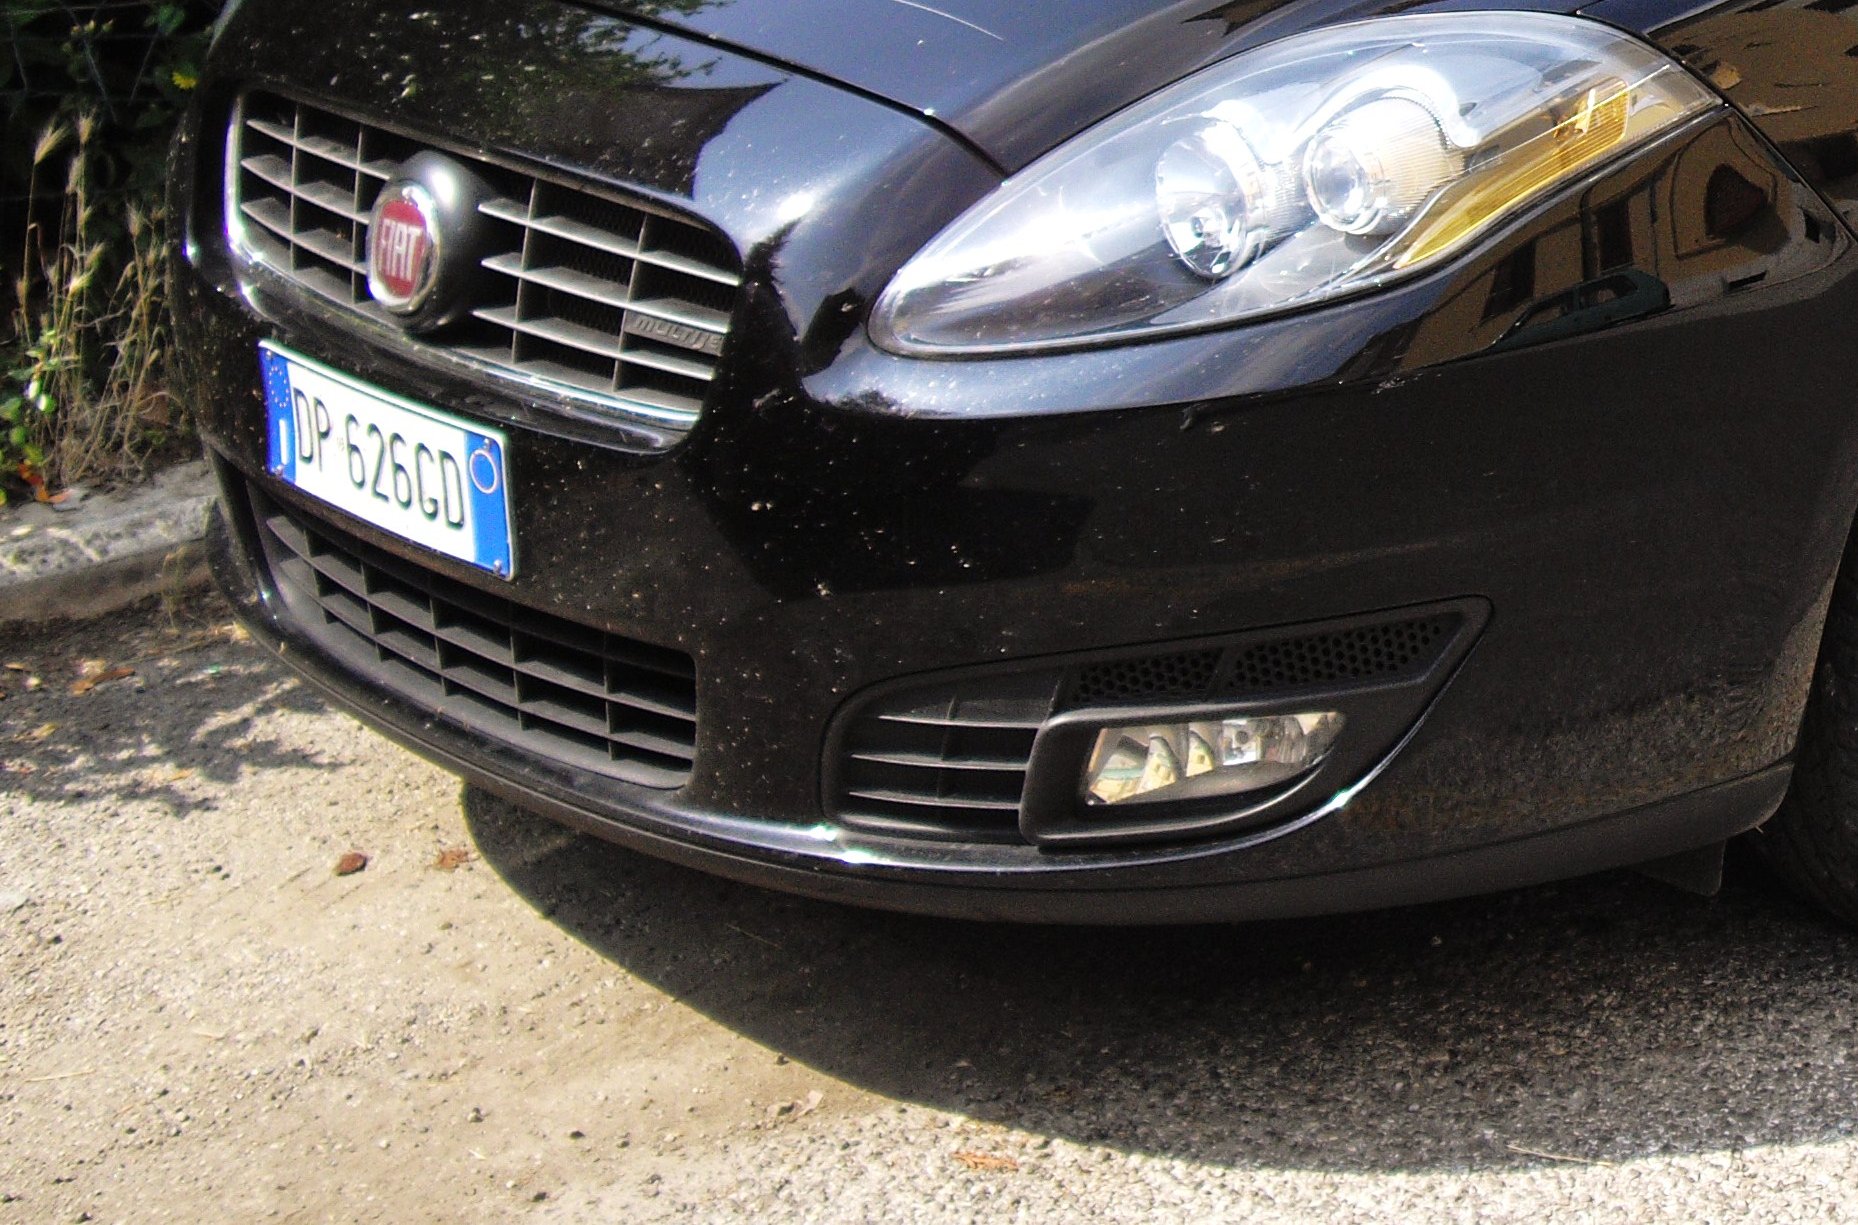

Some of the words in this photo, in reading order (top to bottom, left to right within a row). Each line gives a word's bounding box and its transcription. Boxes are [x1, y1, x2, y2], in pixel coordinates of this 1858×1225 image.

[378, 217, 424, 282] FIAT
[633, 317, 724, 351] MULTIJE
[292, 386, 332, 473] DP
[344, 412, 465, 531] 626GD
